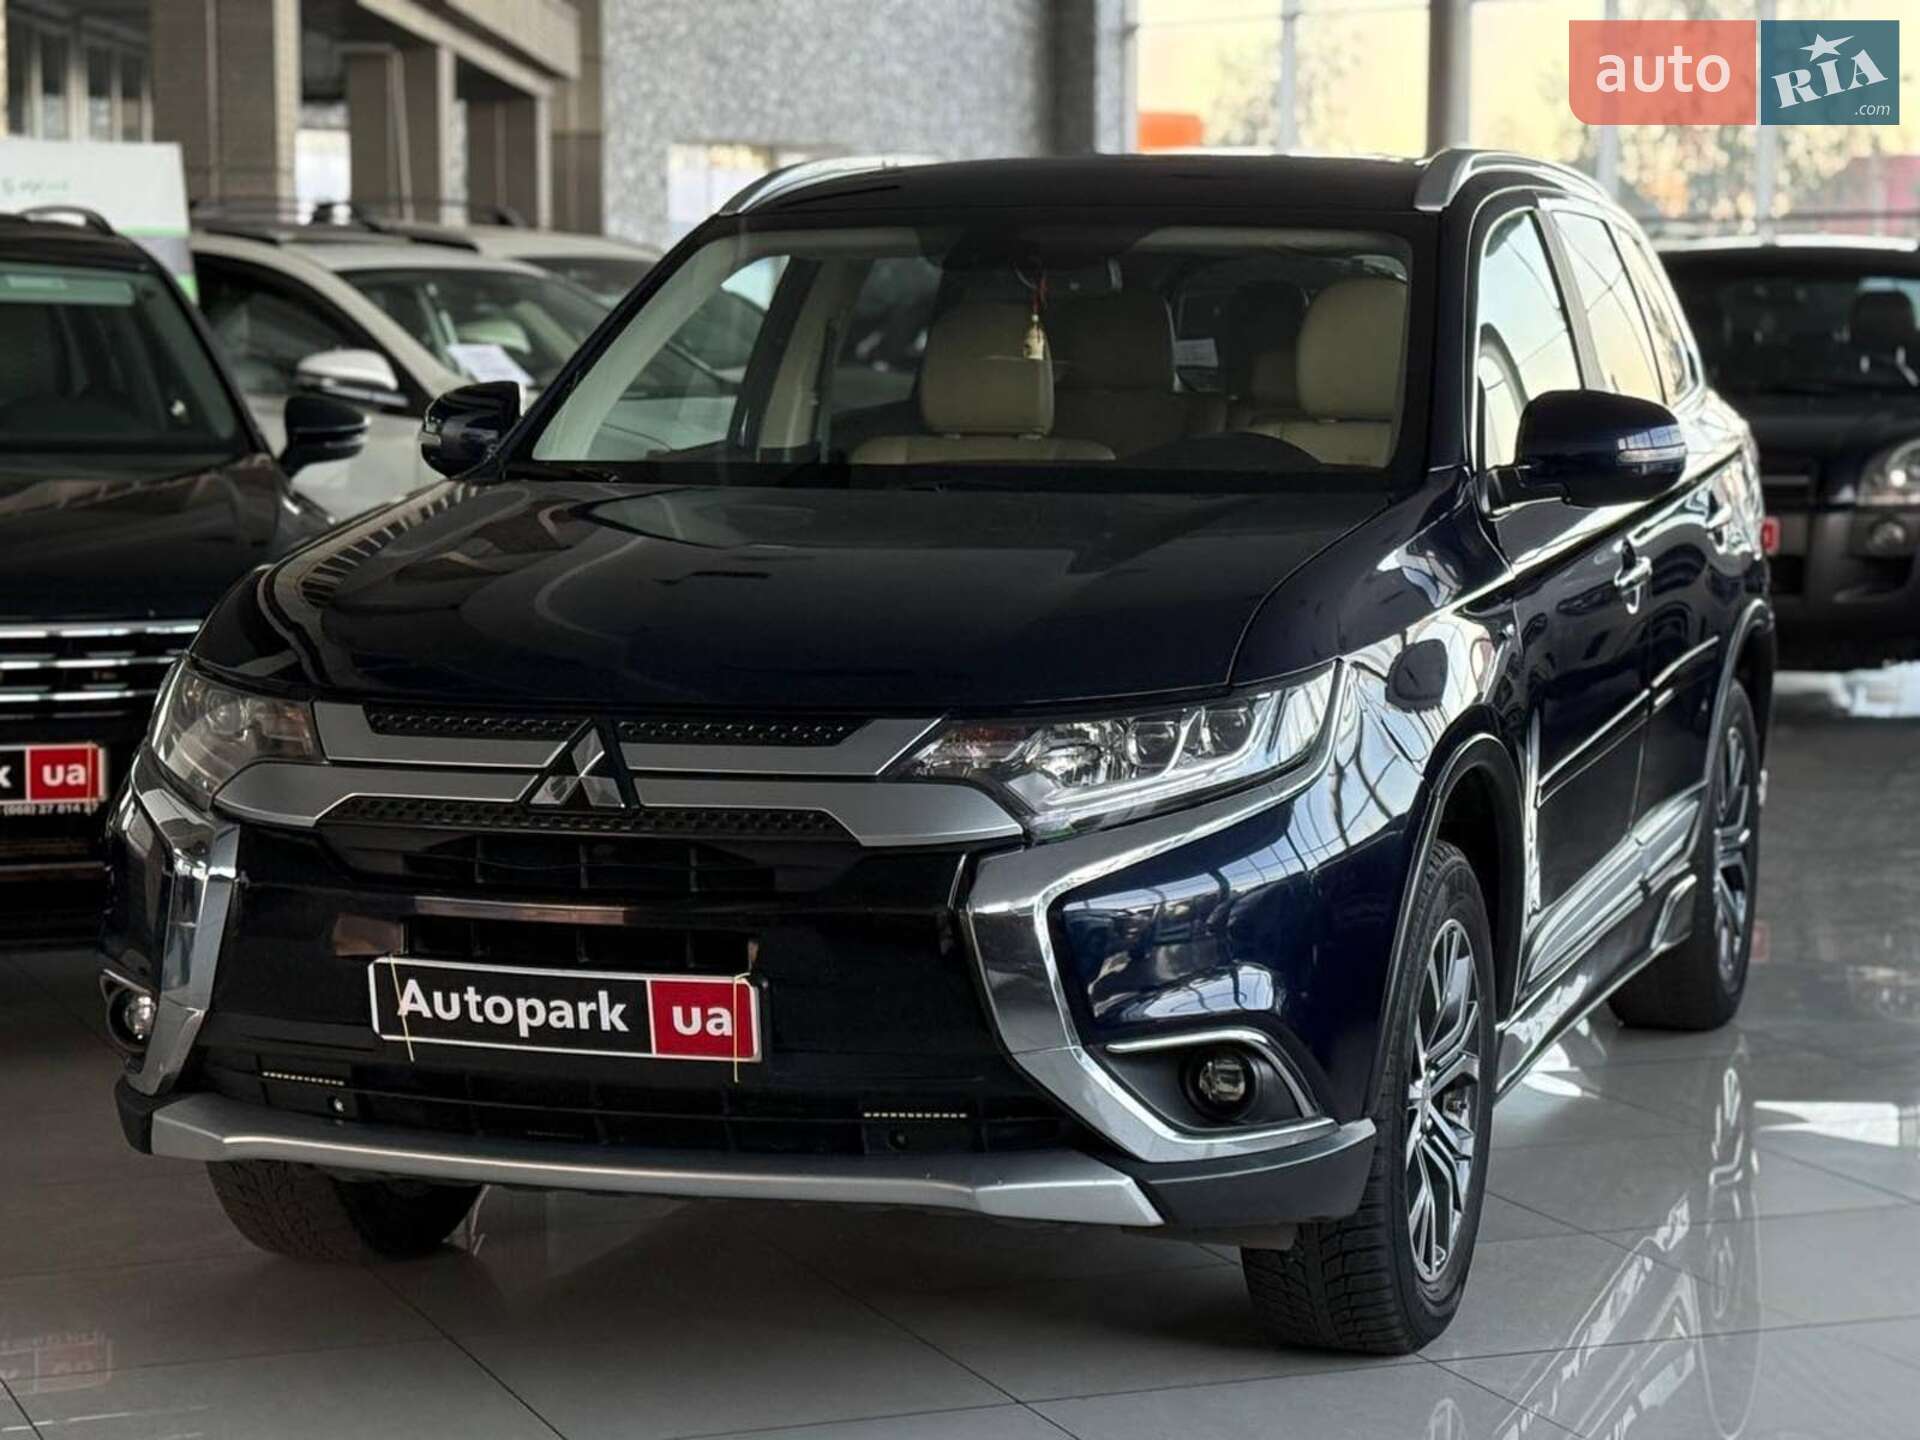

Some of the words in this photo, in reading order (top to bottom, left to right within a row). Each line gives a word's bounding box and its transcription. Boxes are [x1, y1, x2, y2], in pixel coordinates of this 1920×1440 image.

[42, 763, 87, 787] ua
[398, 978, 630, 1038] Autopark
[671, 1004, 734, 1037] ua
